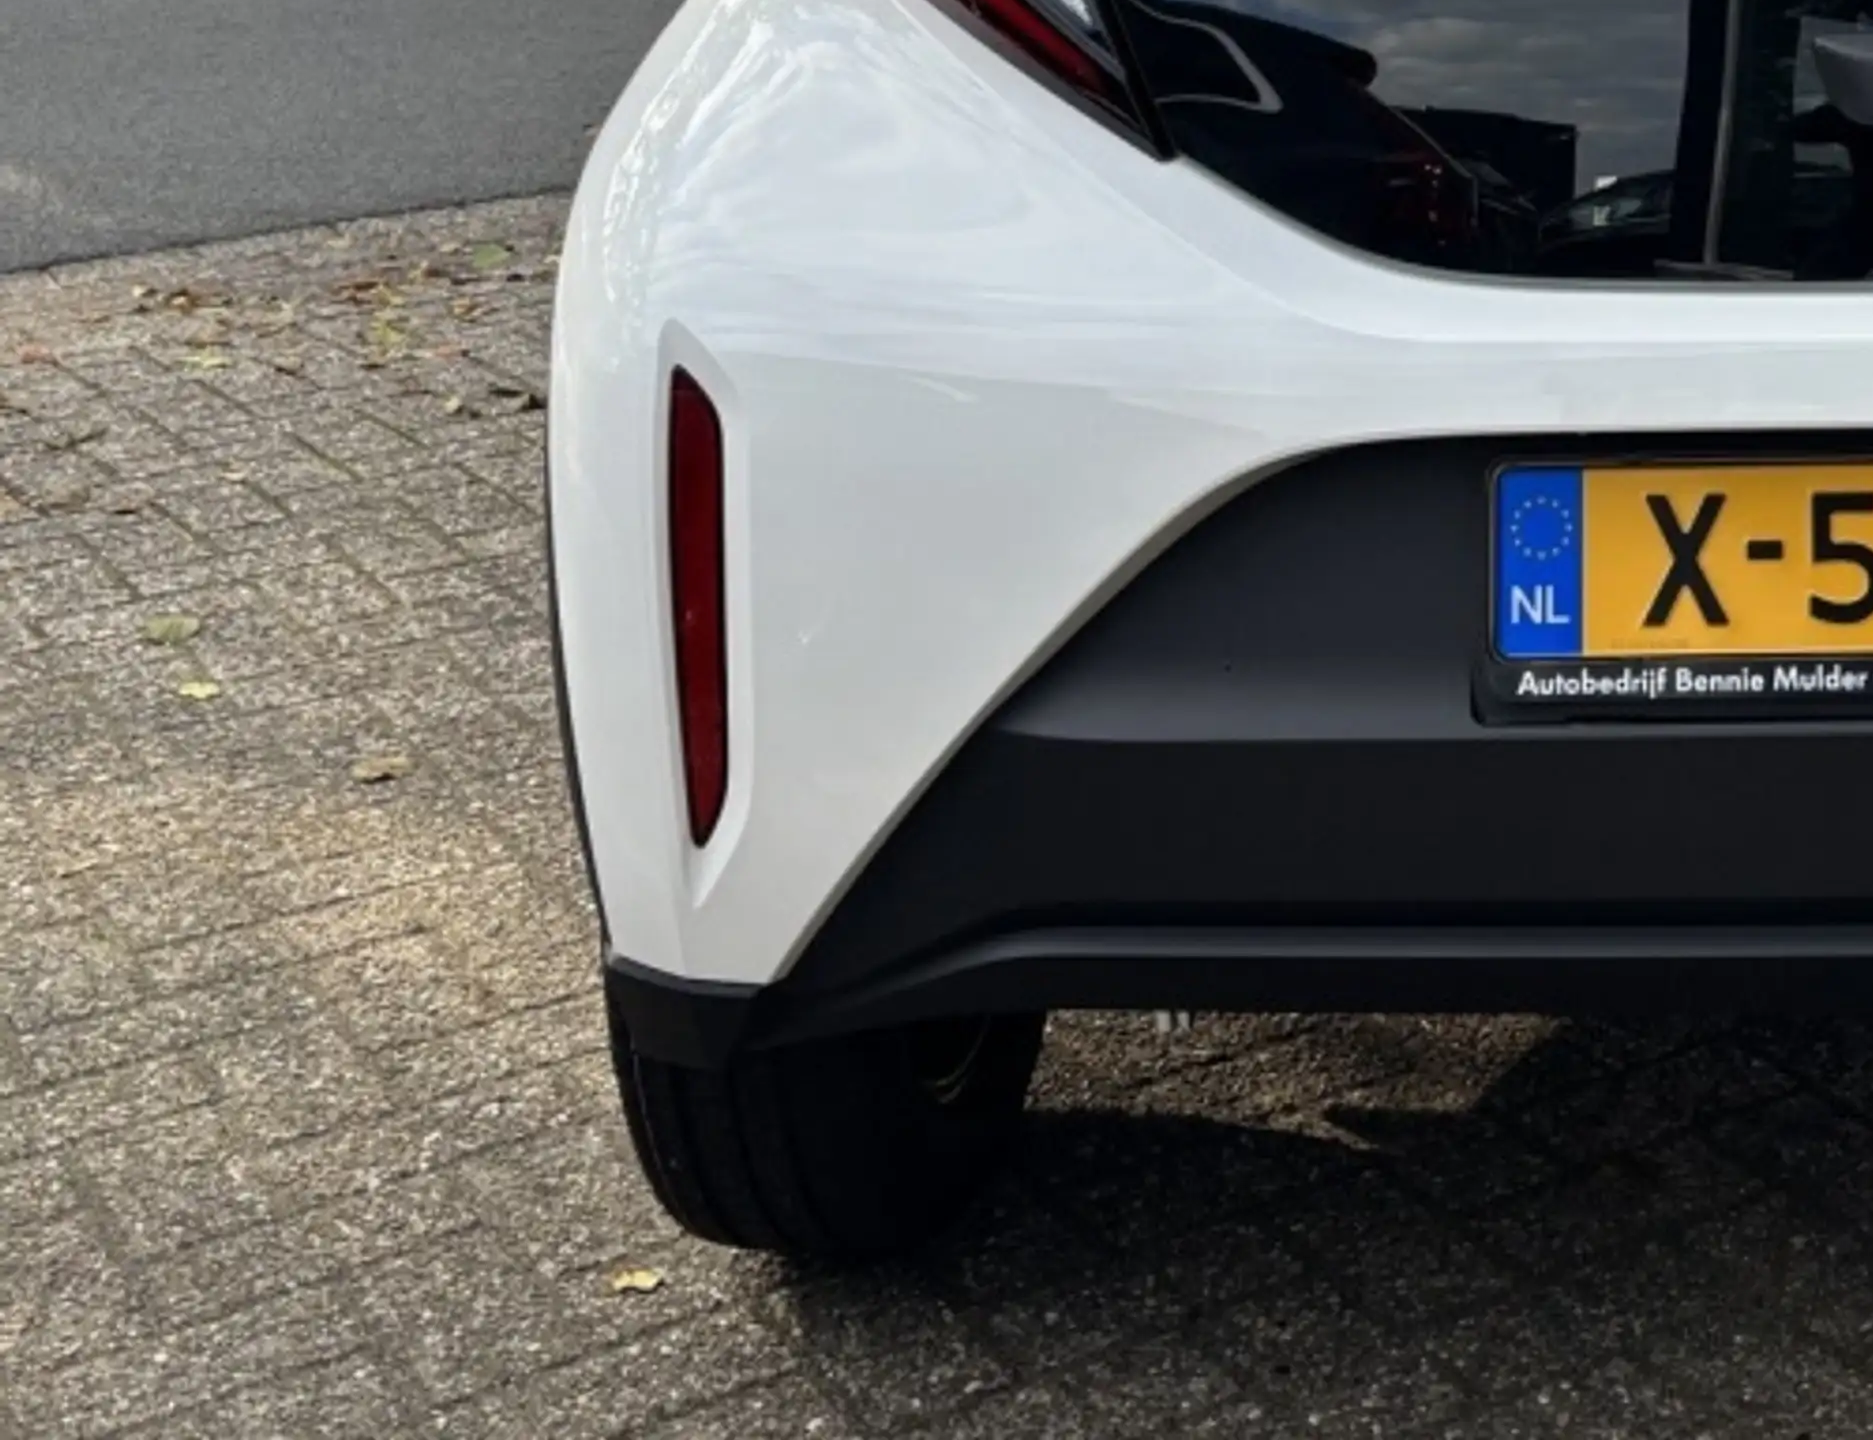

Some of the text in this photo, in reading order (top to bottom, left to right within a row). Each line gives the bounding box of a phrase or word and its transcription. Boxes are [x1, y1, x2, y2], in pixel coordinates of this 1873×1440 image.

[1511, 586, 1570, 624] NL
[1516, 667, 1667, 699] Autobedrijf
[1676, 667, 1764, 692] Bennie
[1773, 665, 1868, 691] Mulder
